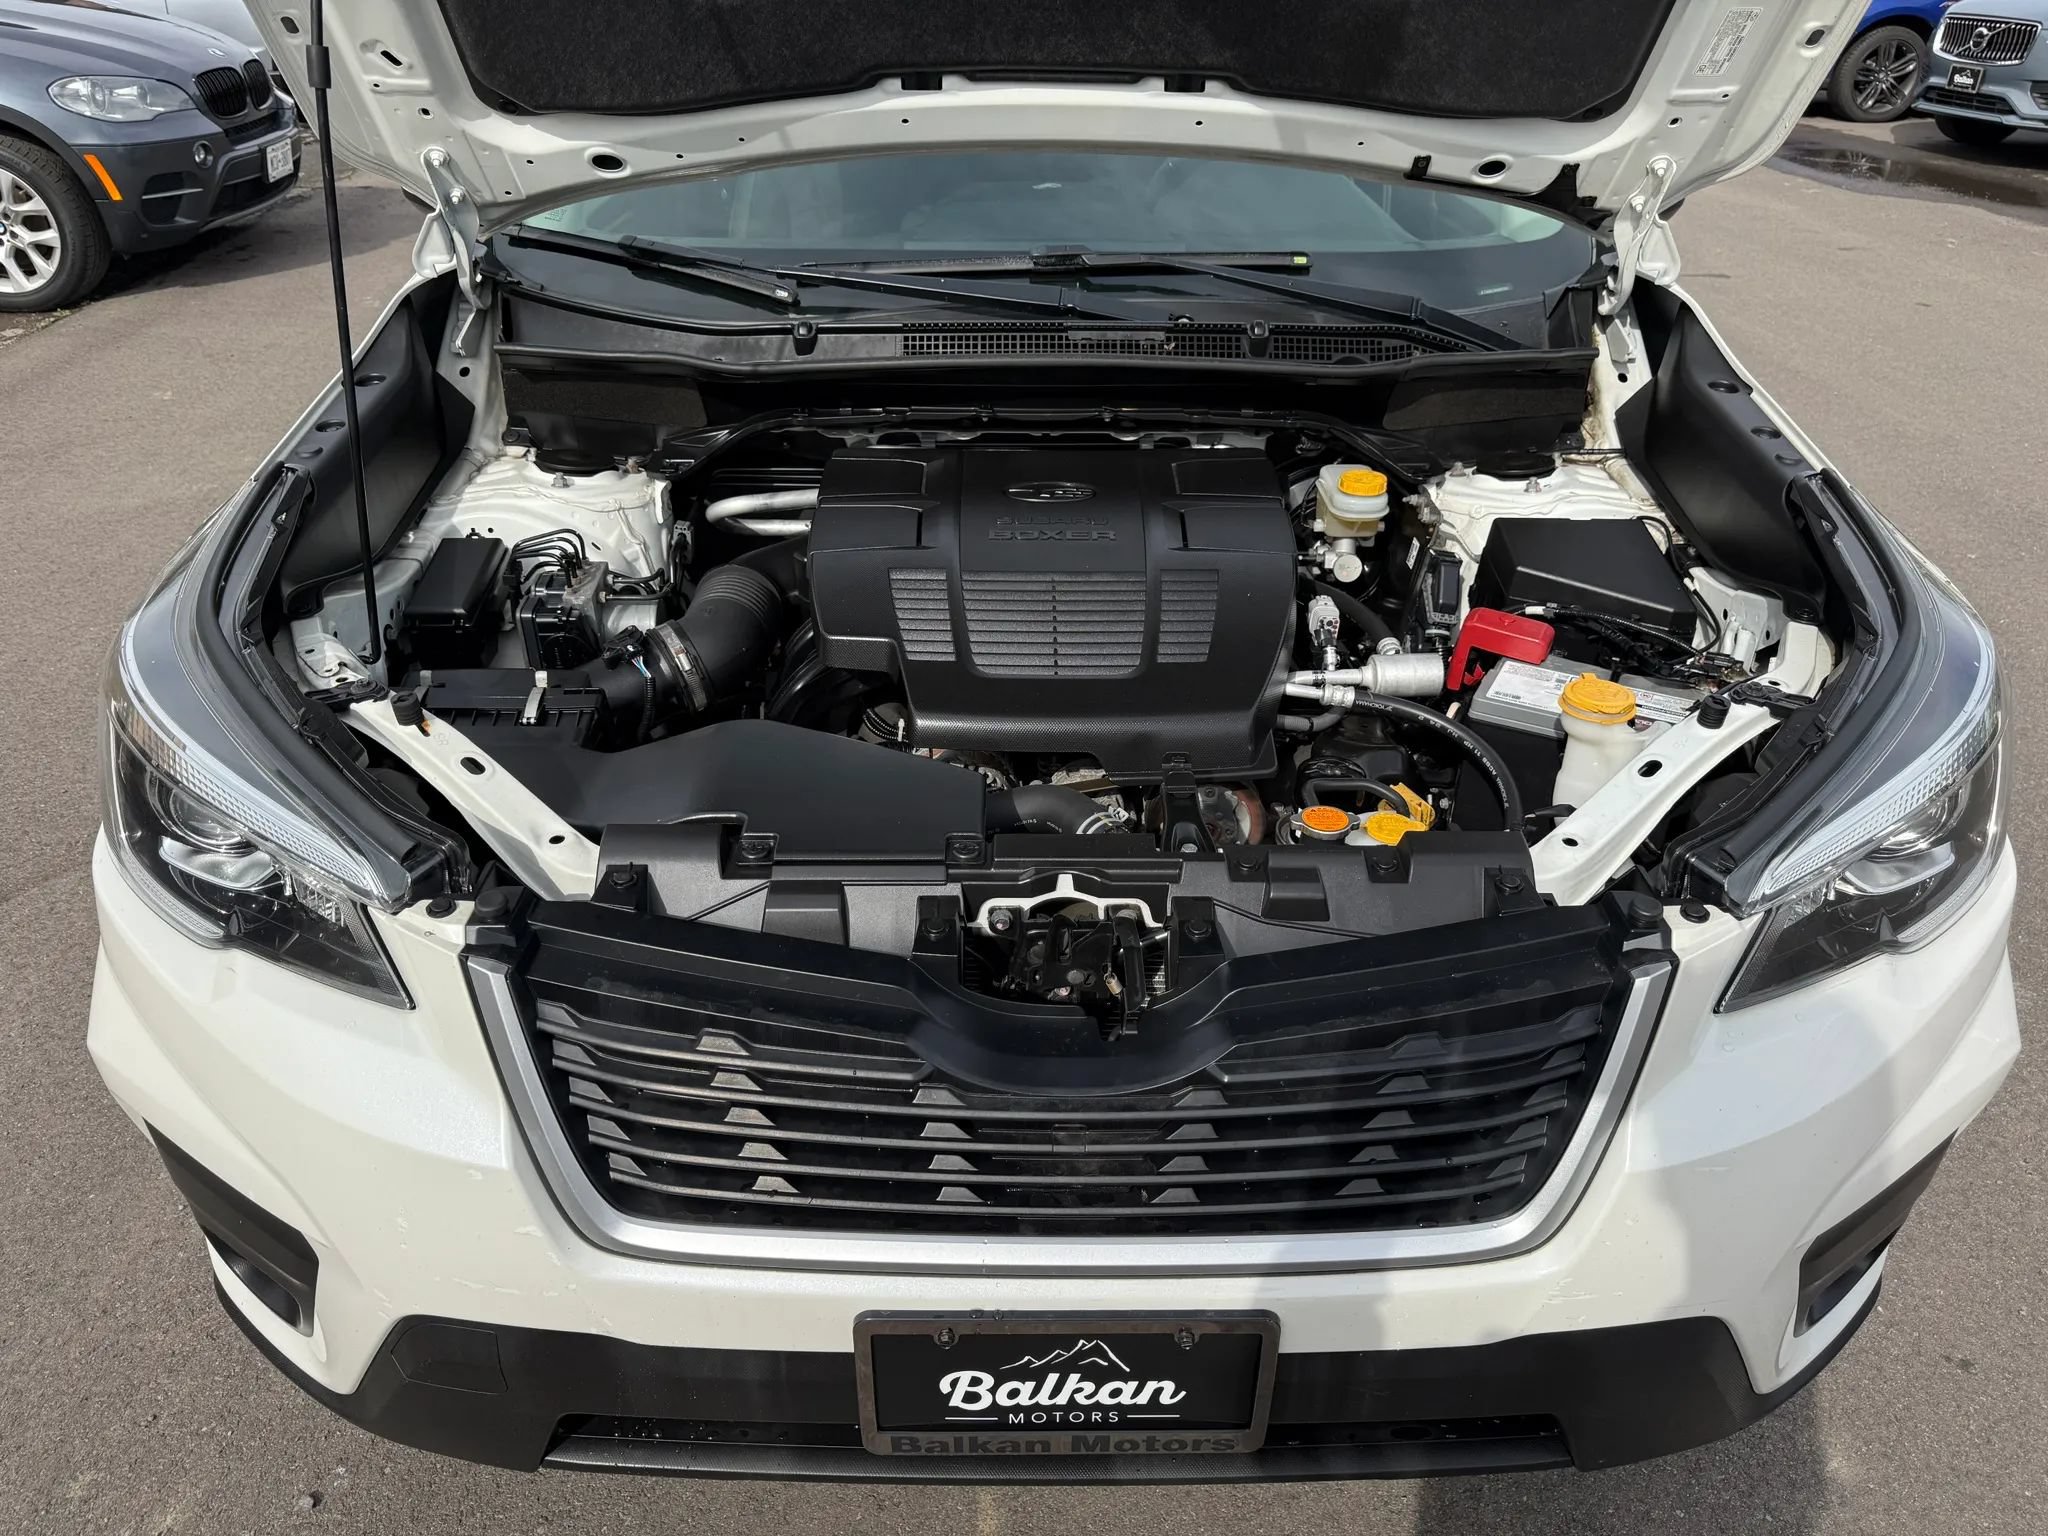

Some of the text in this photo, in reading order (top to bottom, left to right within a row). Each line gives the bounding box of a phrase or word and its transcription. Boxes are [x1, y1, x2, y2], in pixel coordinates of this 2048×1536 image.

[997, 516, 1109, 525] SUBARU
[988, 530, 1117, 541] BOXER
[938, 1370, 1187, 1411] Balkan
[1008, 1411, 1119, 1424] MOTORS
[891, 1434, 1238, 1455] Balkan Motors
